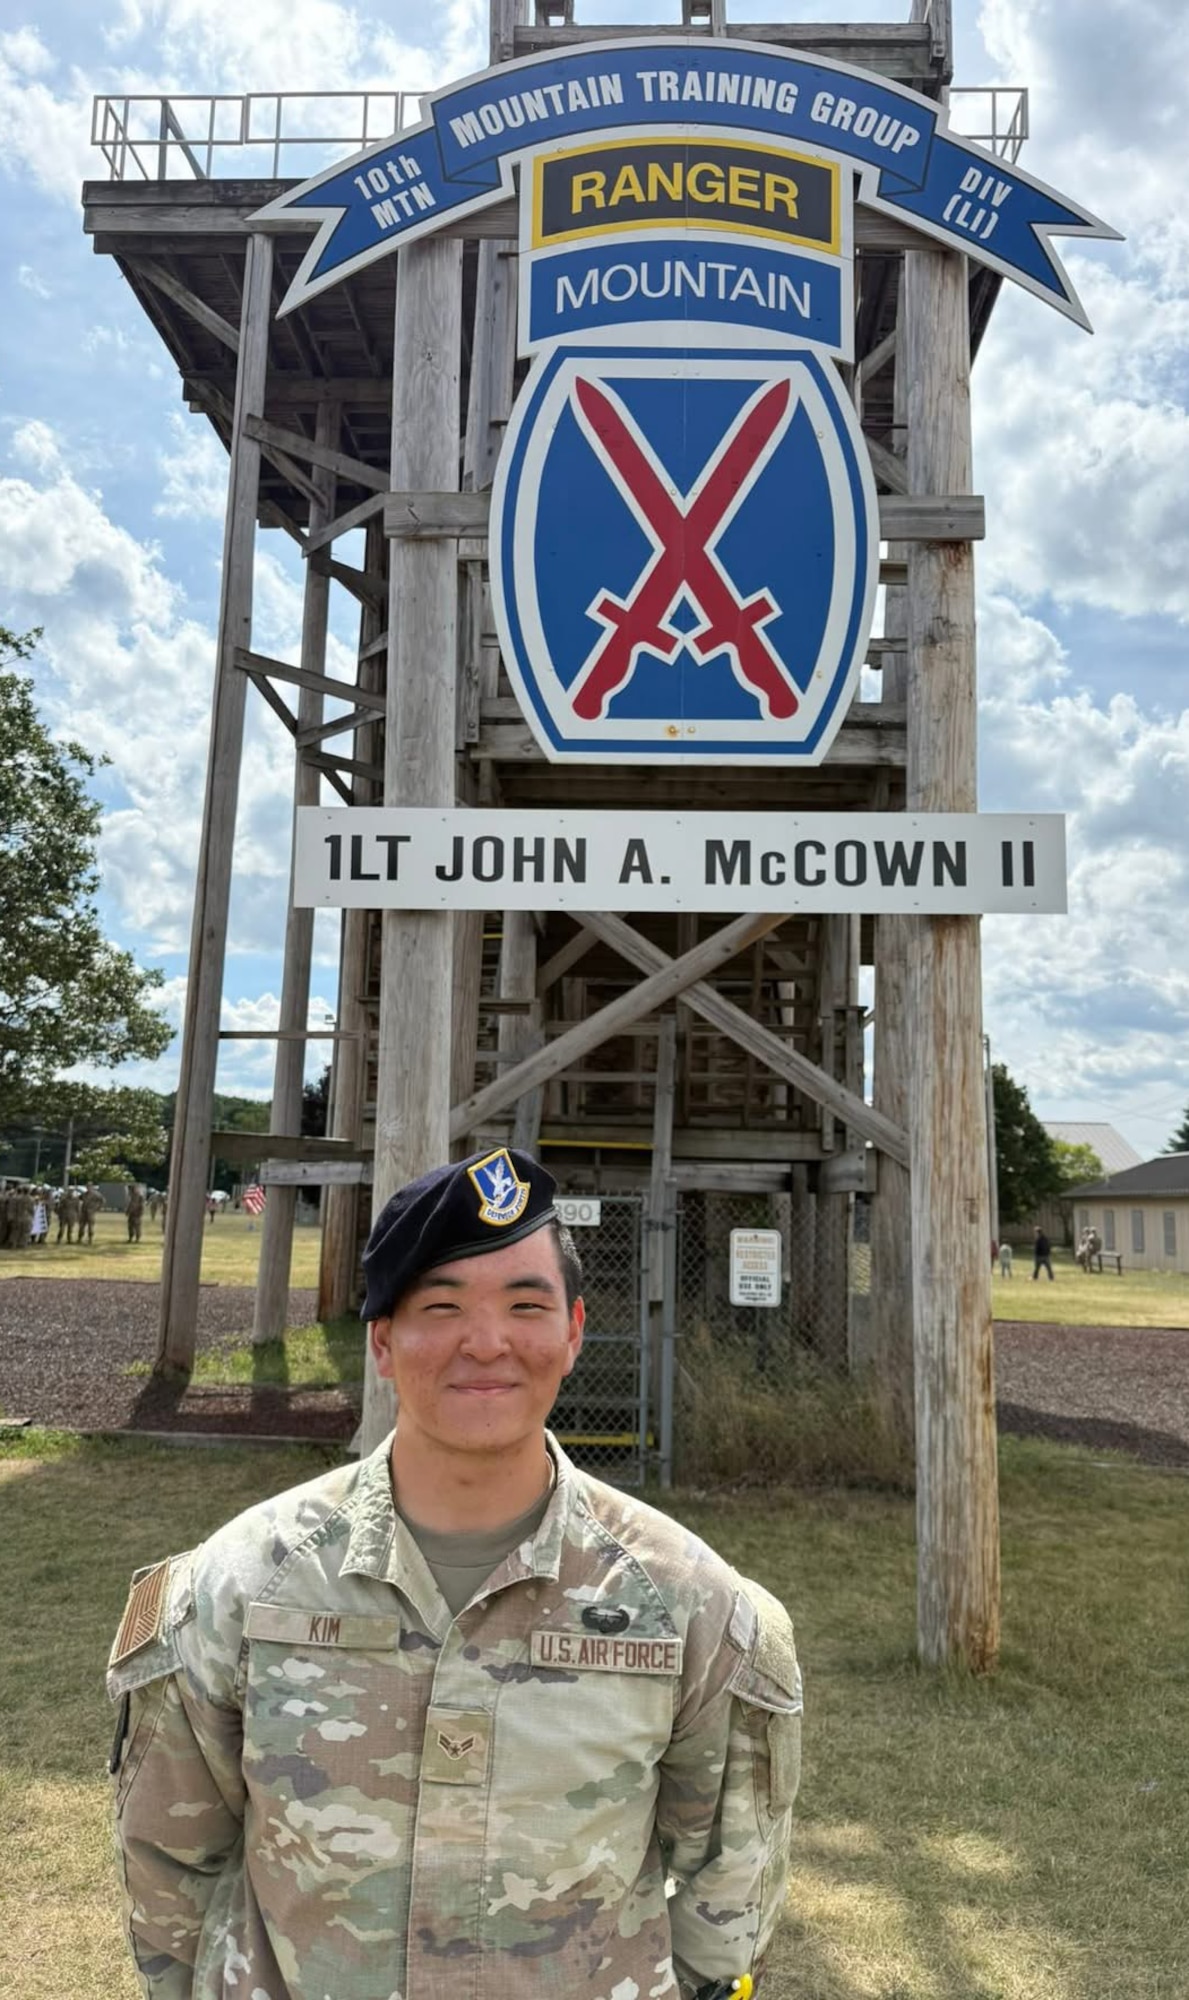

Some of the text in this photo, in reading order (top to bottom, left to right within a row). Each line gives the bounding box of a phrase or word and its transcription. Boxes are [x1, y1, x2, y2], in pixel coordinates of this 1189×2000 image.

[448, 70, 921, 154] MOUNTAIN TRAINING GROUP
[354, 155, 422, 200] 10th
[570, 162, 799, 219] RANGER
[959, 166, 1013, 207] DIV
[370, 181, 436, 230] MTN
[942, 194, 999, 239] (LI)
[556, 260, 811, 319] MOUNTAIN
[324, 835, 1035, 887] 1LT JOHN A. McCOWN II
[309, 1616, 341, 1643] KIM
[540, 1635, 676, 1669] U.S. AIR FORCE
